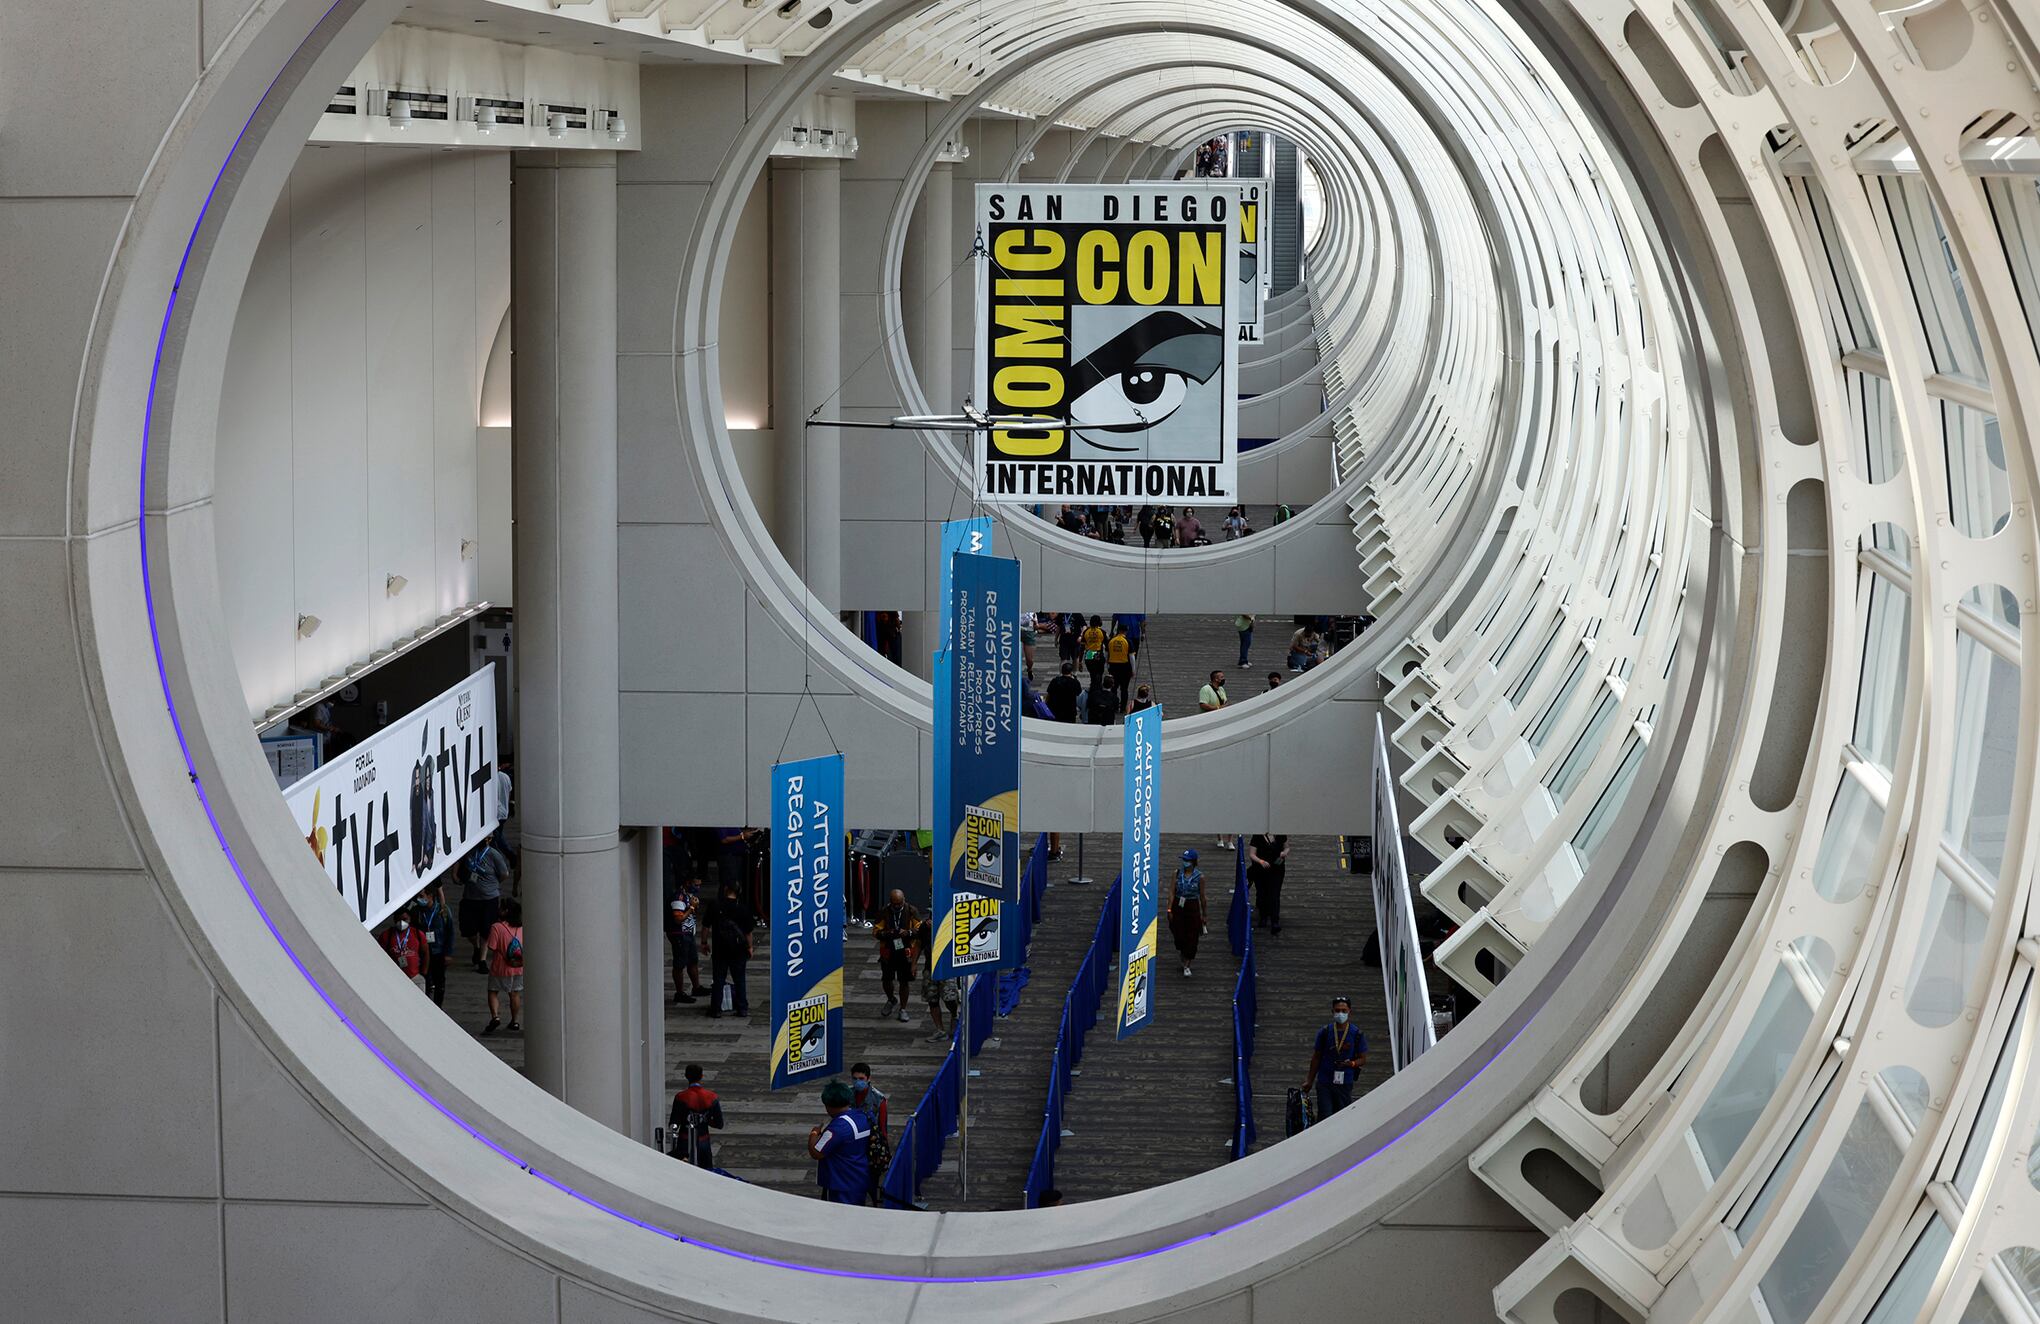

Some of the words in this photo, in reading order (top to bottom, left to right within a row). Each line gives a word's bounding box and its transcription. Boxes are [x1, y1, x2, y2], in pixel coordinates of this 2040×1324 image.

[989, 194, 1062, 221] SAN
[1104, 195, 1227, 222] DIEGO
[1076, 229, 1222, 305] CON
[992, 228, 1067, 457] COMIC
[986, 464, 1226, 497] INTERNATIONAL
[959, 655, 967, 746] PARTICIPANTS
[967, 662, 975, 733] RELATIONS
[985, 590, 997, 745] REGISTRATION
[1001, 620, 1012, 732] INDUSTRY
[975, 669, 983, 755] PROS/PRESS
[1133, 717, 1143, 842] PORTFOLIO
[967, 815, 979, 870] COMIC
[978, 817, 1001, 839] CON
[1142, 741, 1153, 900] AUTOGRAPHS/
[787, 776, 804, 977] REGISTRATION
[813, 800, 829, 944] ATTENDEE
[954, 894, 970, 902] SAN
[970, 898, 998, 919] CON
[1131, 852, 1141, 935] REVIEW
[954, 951, 999, 965] INTERNATIONAL
[955, 901, 970, 956] COMIC
[789, 1009, 801, 1062] COMIC
[802, 1004, 825, 1024] CON
